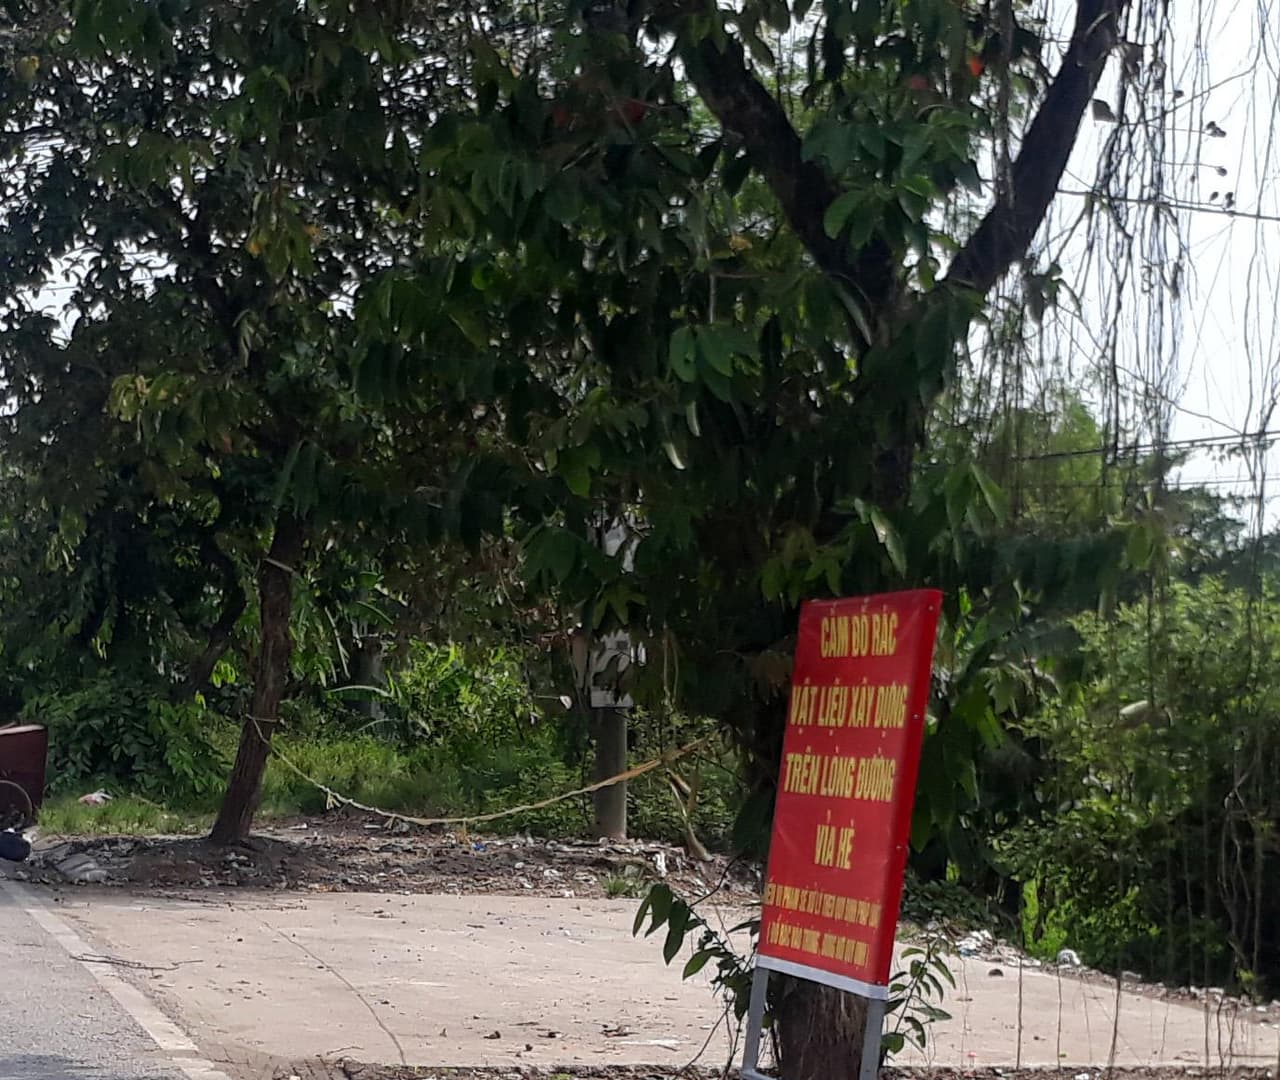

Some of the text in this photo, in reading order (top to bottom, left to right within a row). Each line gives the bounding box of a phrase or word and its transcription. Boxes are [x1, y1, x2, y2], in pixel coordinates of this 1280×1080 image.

[821, 601, 849, 658] CẤM
[871, 604, 898, 656] RÁC
[790, 677, 818, 735] VẬT
[817, 677, 848, 737] LIỆU
[847, 677, 875, 728] XÂY
[784, 745, 821, 795] TRÊN
[820, 745, 856, 798] LÒNG
[814, 809, 855, 870] VỈA HÈ
